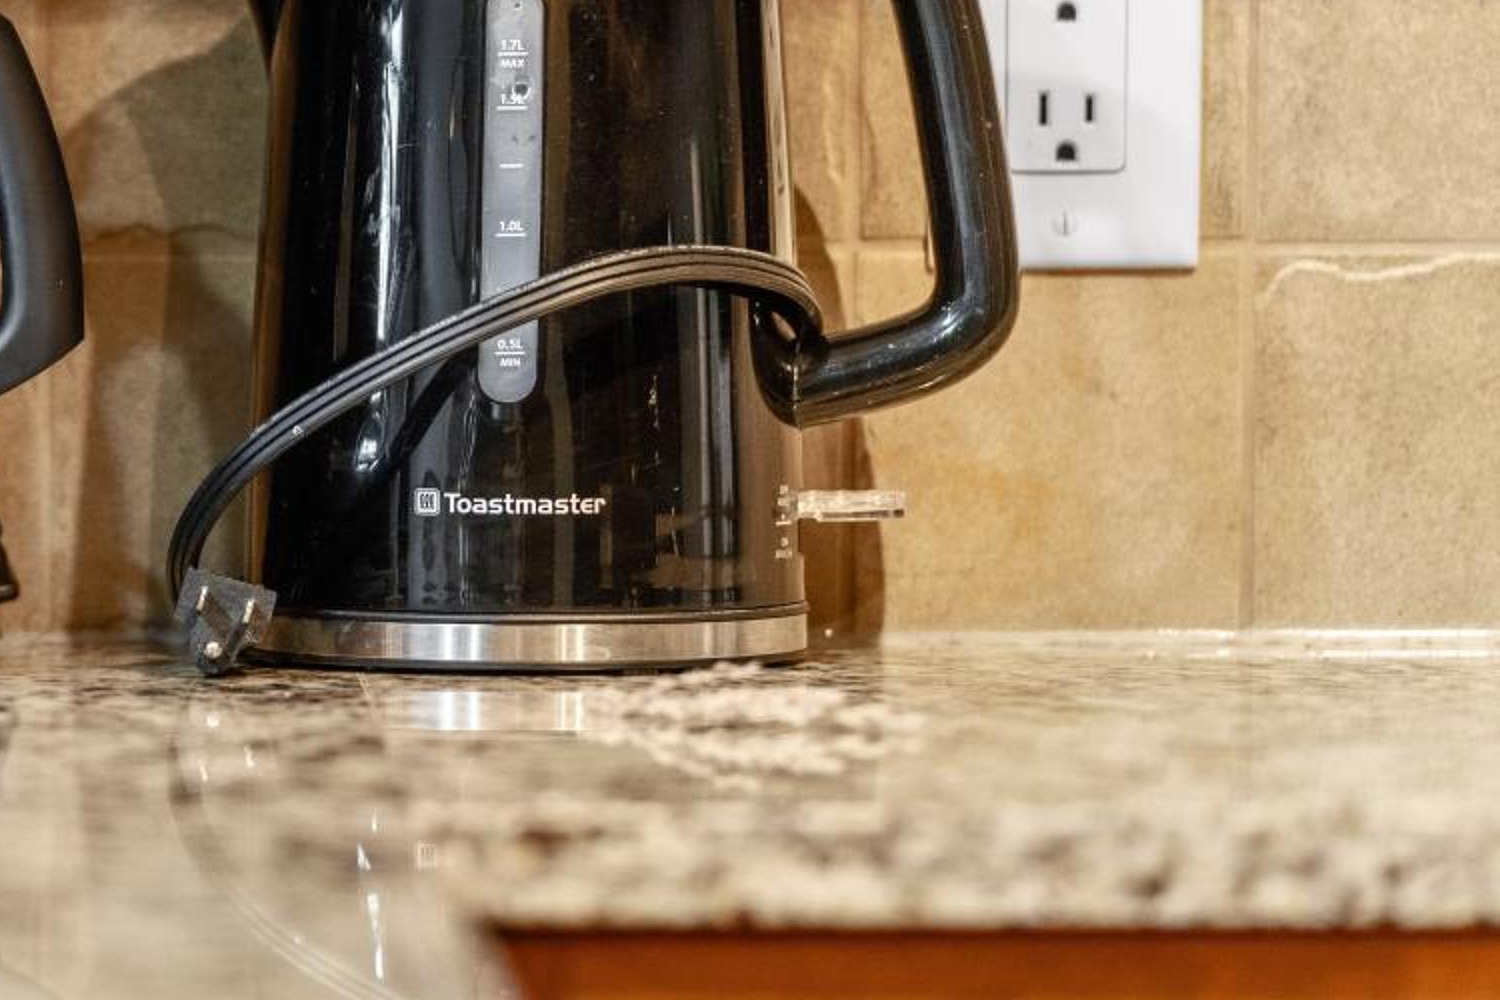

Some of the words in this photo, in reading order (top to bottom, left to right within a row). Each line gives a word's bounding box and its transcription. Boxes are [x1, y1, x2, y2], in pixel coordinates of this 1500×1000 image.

[501, 39, 525, 51] 1.7L
[500, 58, 524, 69] MAX
[499, 220, 524, 233] 1.0L
[499, 358, 521, 367] MIN
[443, 492, 607, 515] Toastmaster
